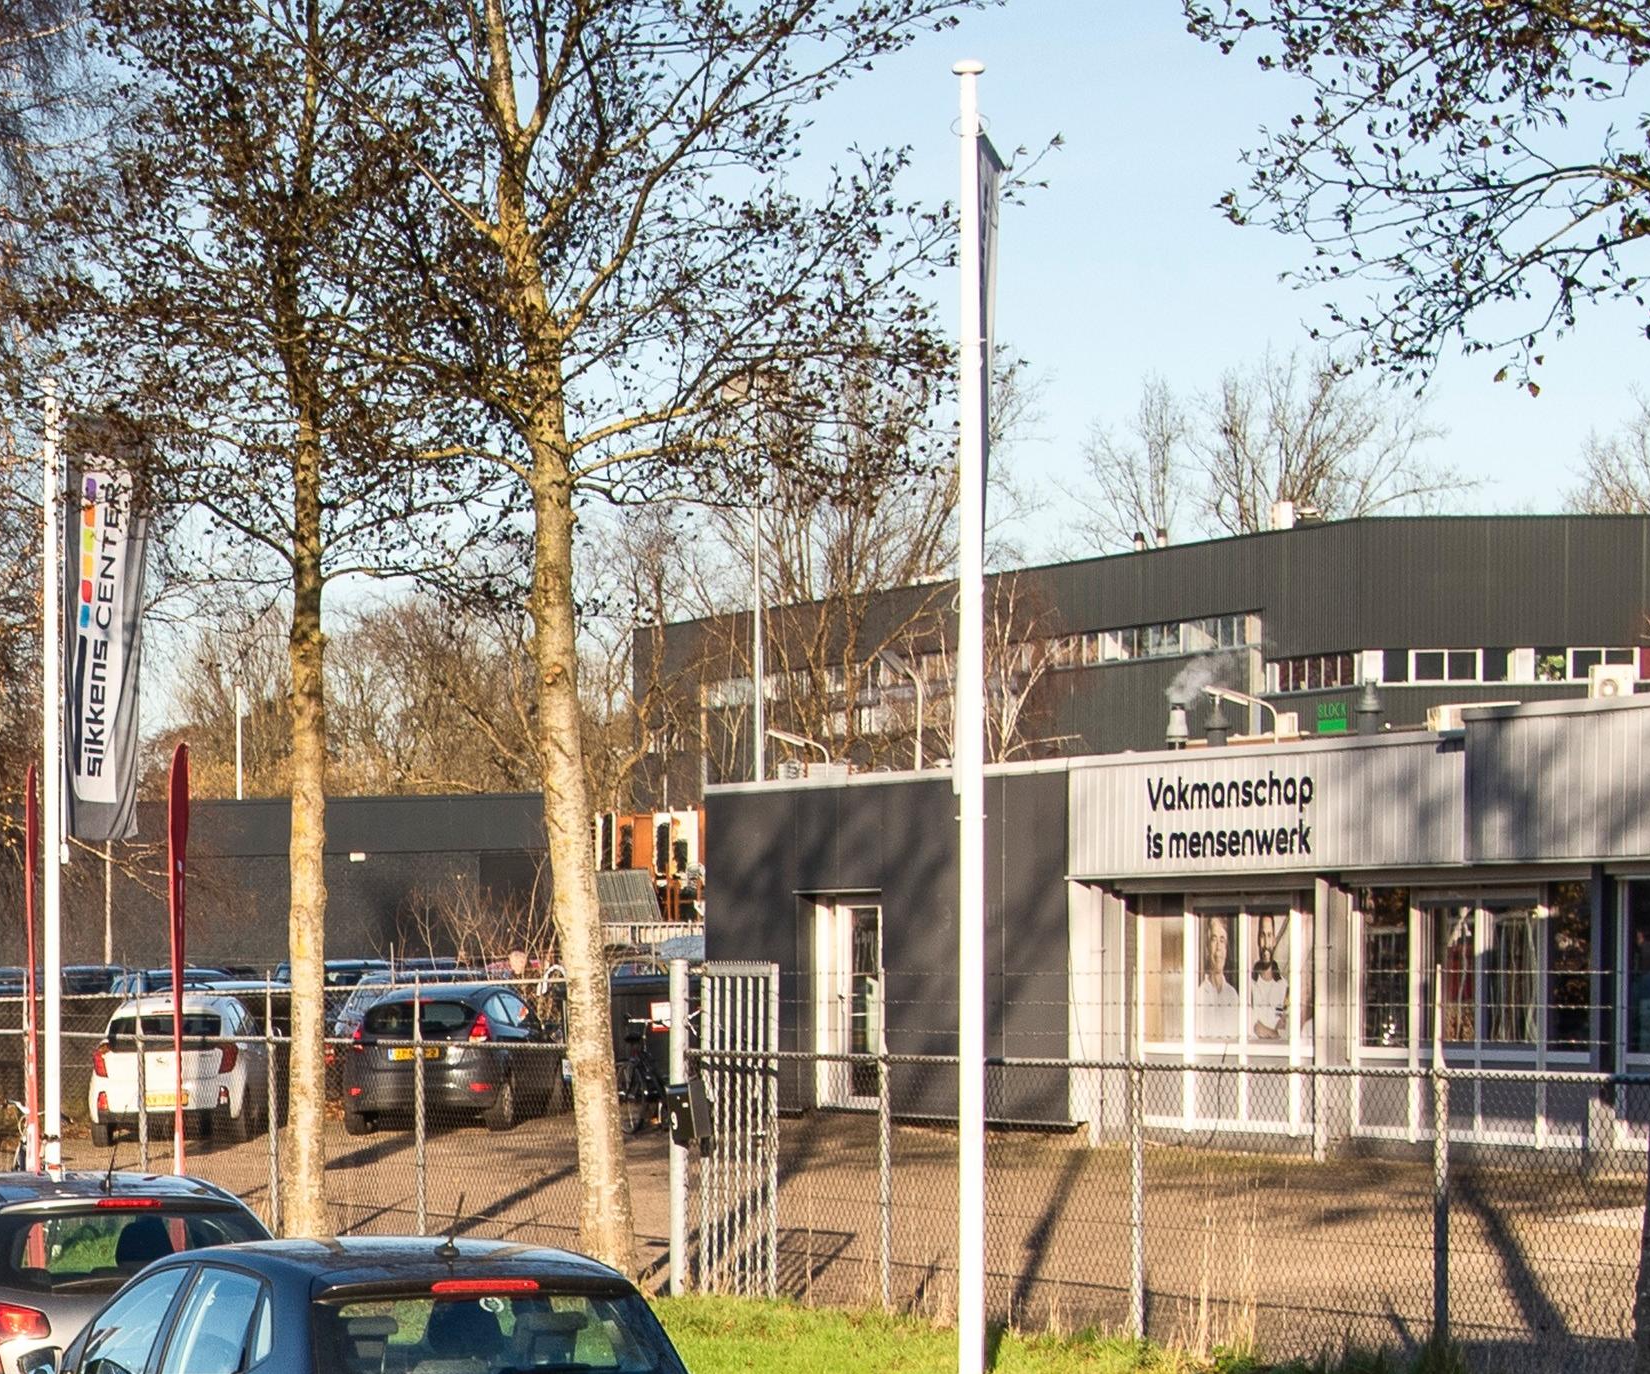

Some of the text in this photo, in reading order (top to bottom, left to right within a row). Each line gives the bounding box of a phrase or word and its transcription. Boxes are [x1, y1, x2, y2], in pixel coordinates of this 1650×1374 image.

[95, 481, 120, 630] CENTER
[1146, 770, 1314, 813] Vakmanschap
[1146, 818, 1312, 860] is mensenwerk
[670, 1111, 679, 1131] 9
